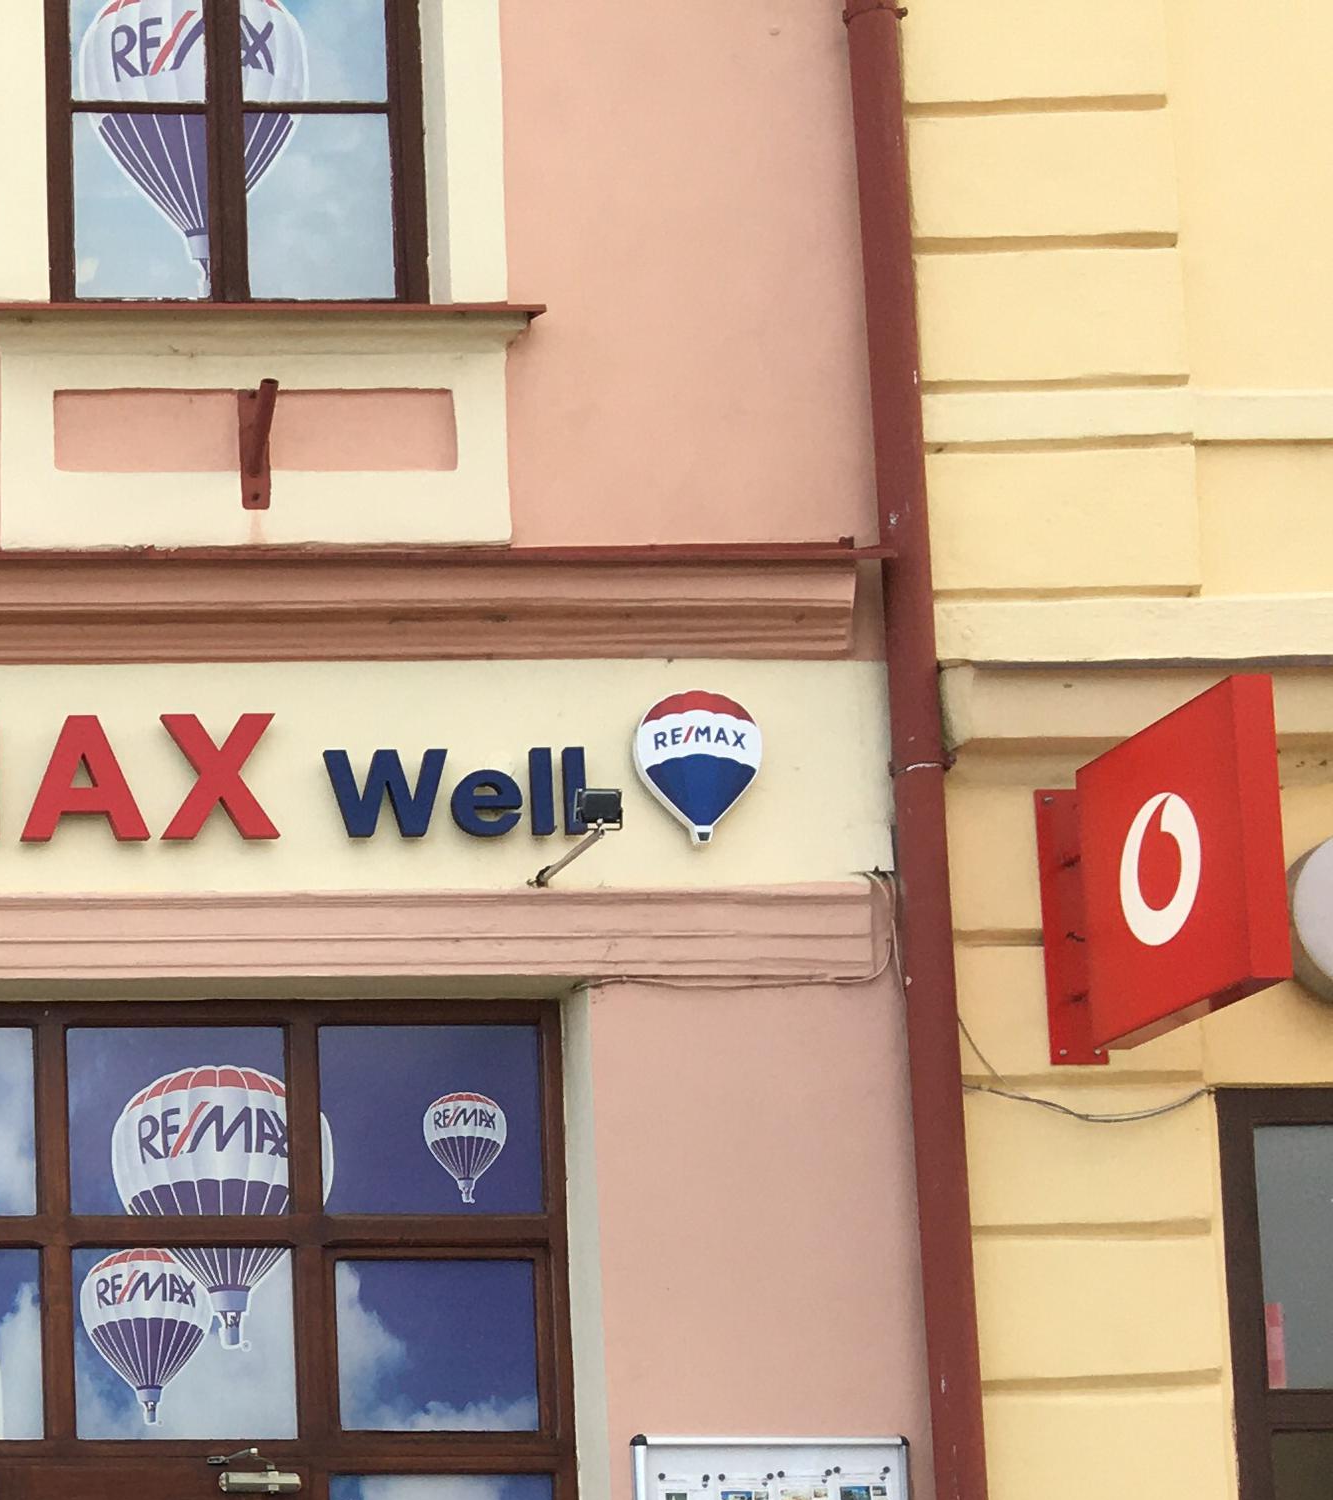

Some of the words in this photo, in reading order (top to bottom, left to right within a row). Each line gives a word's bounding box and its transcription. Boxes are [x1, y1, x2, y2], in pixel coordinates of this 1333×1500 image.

[653, 725, 747, 751] RE/MAX
[322, 746, 588, 838] Well
[138, 1101, 289, 1164] RE/MAX
[433, 1106, 496, 1130] RE/MAX
[96, 1270, 196, 1309] RE/MAX
